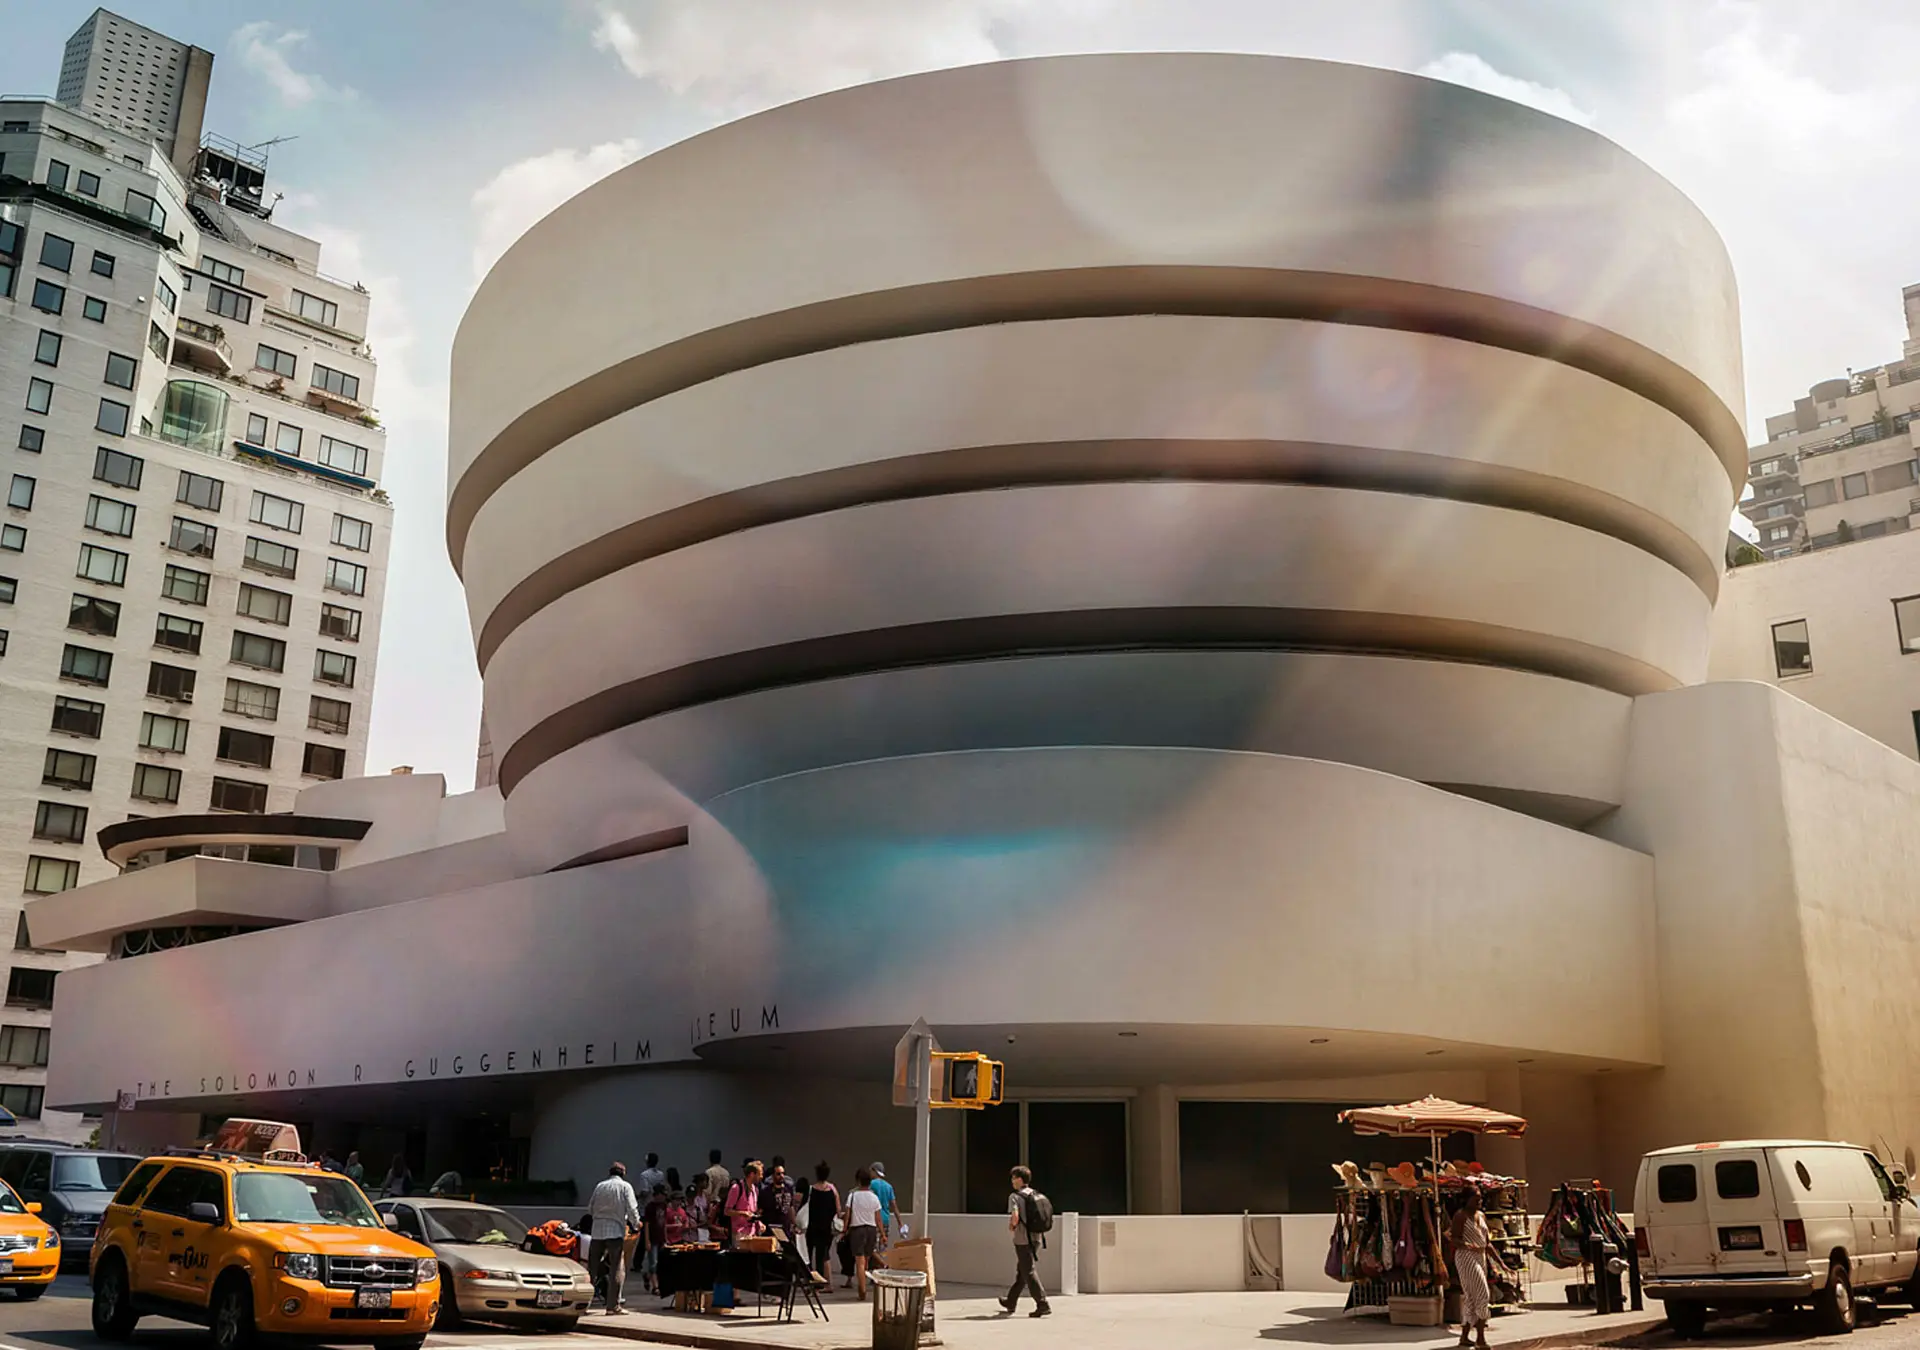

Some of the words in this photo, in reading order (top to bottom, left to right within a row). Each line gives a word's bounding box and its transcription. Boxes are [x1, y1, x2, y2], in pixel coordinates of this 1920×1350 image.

[137, 1080, 171, 1098] THE
[200, 1069, 316, 1093] SOLOMON
[354, 1064, 362, 1082] R
[405, 1040, 651, 1078] GUGGENHEIM
